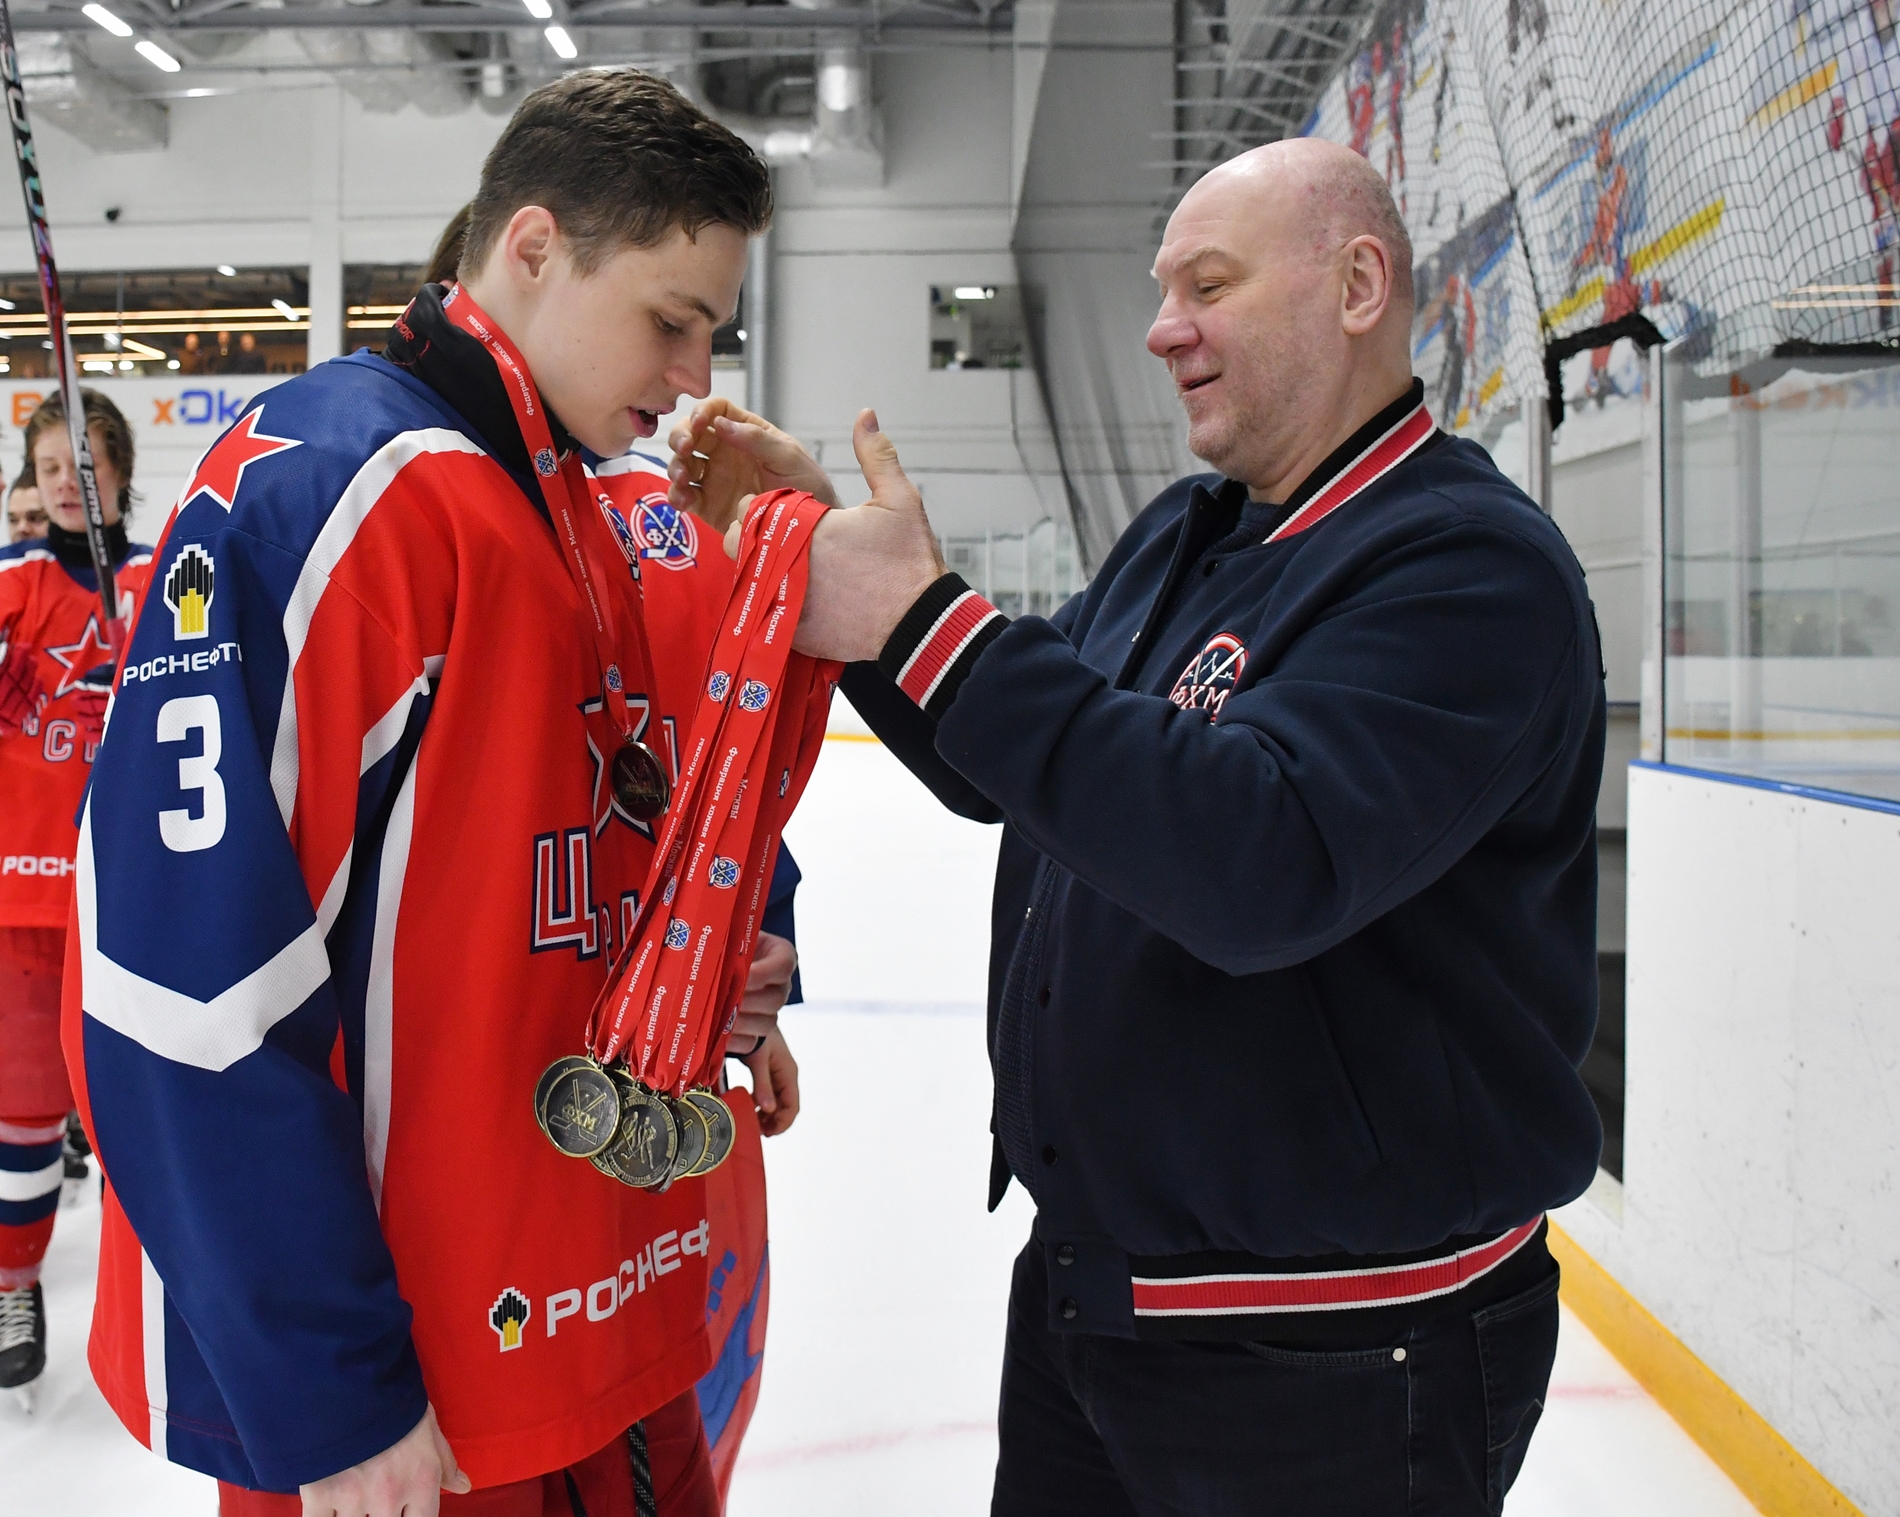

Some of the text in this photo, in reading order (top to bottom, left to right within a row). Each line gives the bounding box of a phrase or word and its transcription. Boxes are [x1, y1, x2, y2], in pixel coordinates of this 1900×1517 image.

[466, 314, 535, 417] Федерация хоккея Москвы
[561, 508, 577, 546] Москвы
[733, 581, 758, 636] Федерация
[754, 544, 769, 579] хоккея
[763, 503, 786, 541] Москвы
[764, 605, 786, 645] Москвы
[157, 694, 227, 853] 3
[677, 780, 691, 814] хоккея
[687, 737, 705, 777] Москвы
[687, 746, 739, 882] Федерация хоккея Москвы
[627, 939, 653, 993] Федерация
[689, 924, 713, 981] Федерация
[614, 995, 631, 1029] хоккея
[645, 984, 667, 1041] Федерация
[680, 983, 695, 1019] хоккея
[668, 1022, 687, 1064] Москвы
